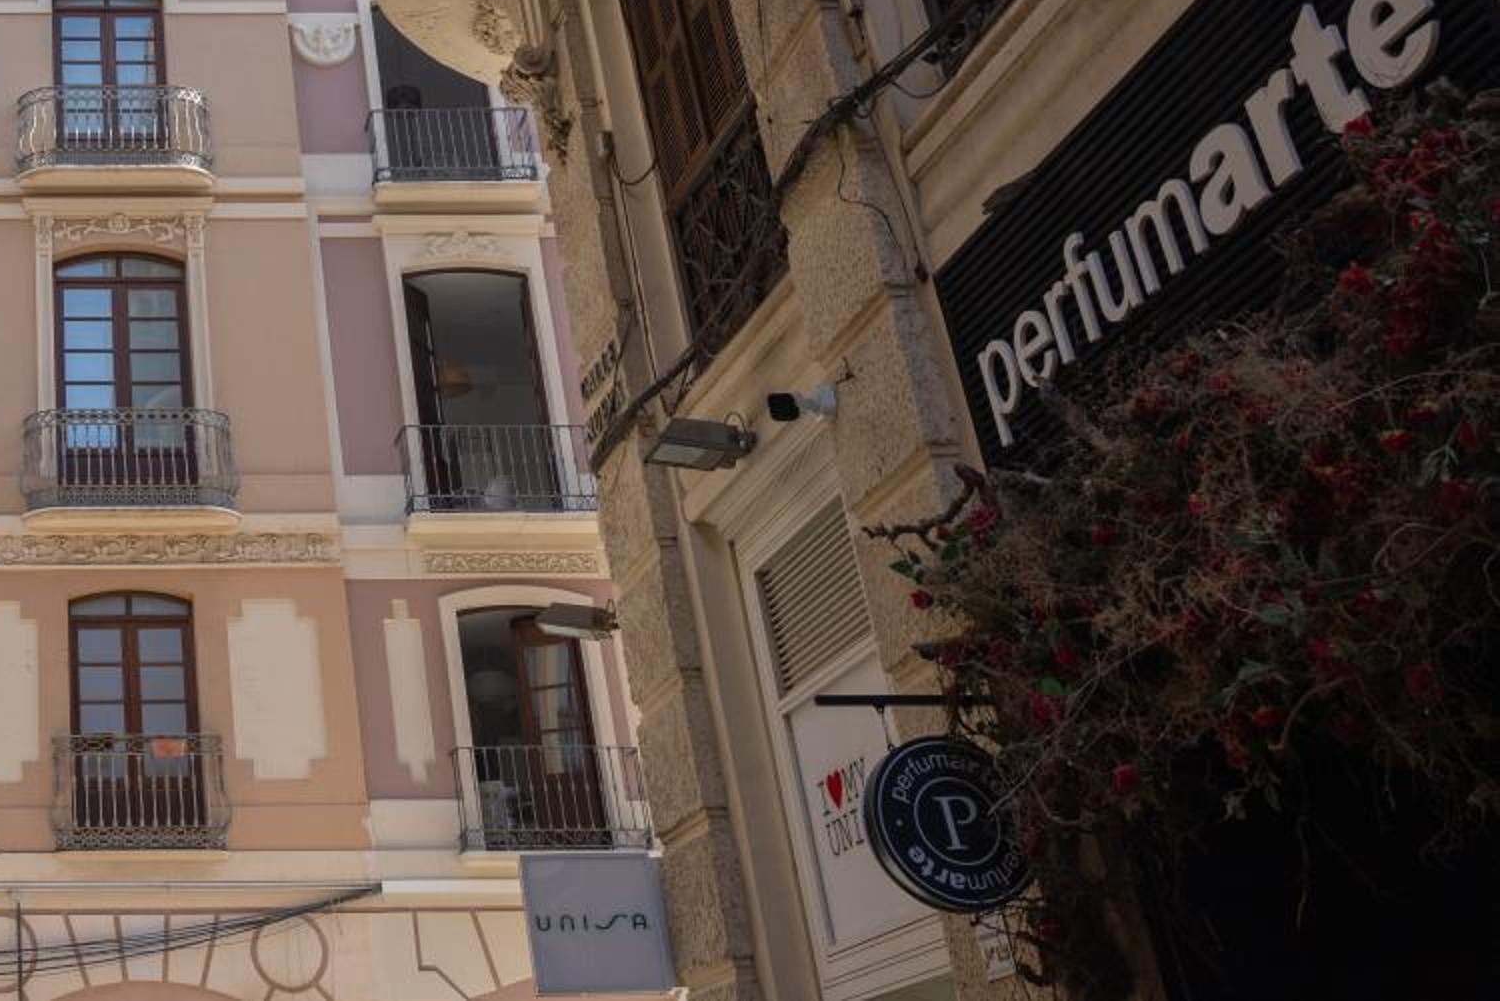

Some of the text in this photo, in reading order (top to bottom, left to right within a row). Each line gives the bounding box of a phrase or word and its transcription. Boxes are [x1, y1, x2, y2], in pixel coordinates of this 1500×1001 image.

[841, 758, 865, 802] MY
[931, 794, 978, 851] P
[534, 910, 650, 933] UNISA
